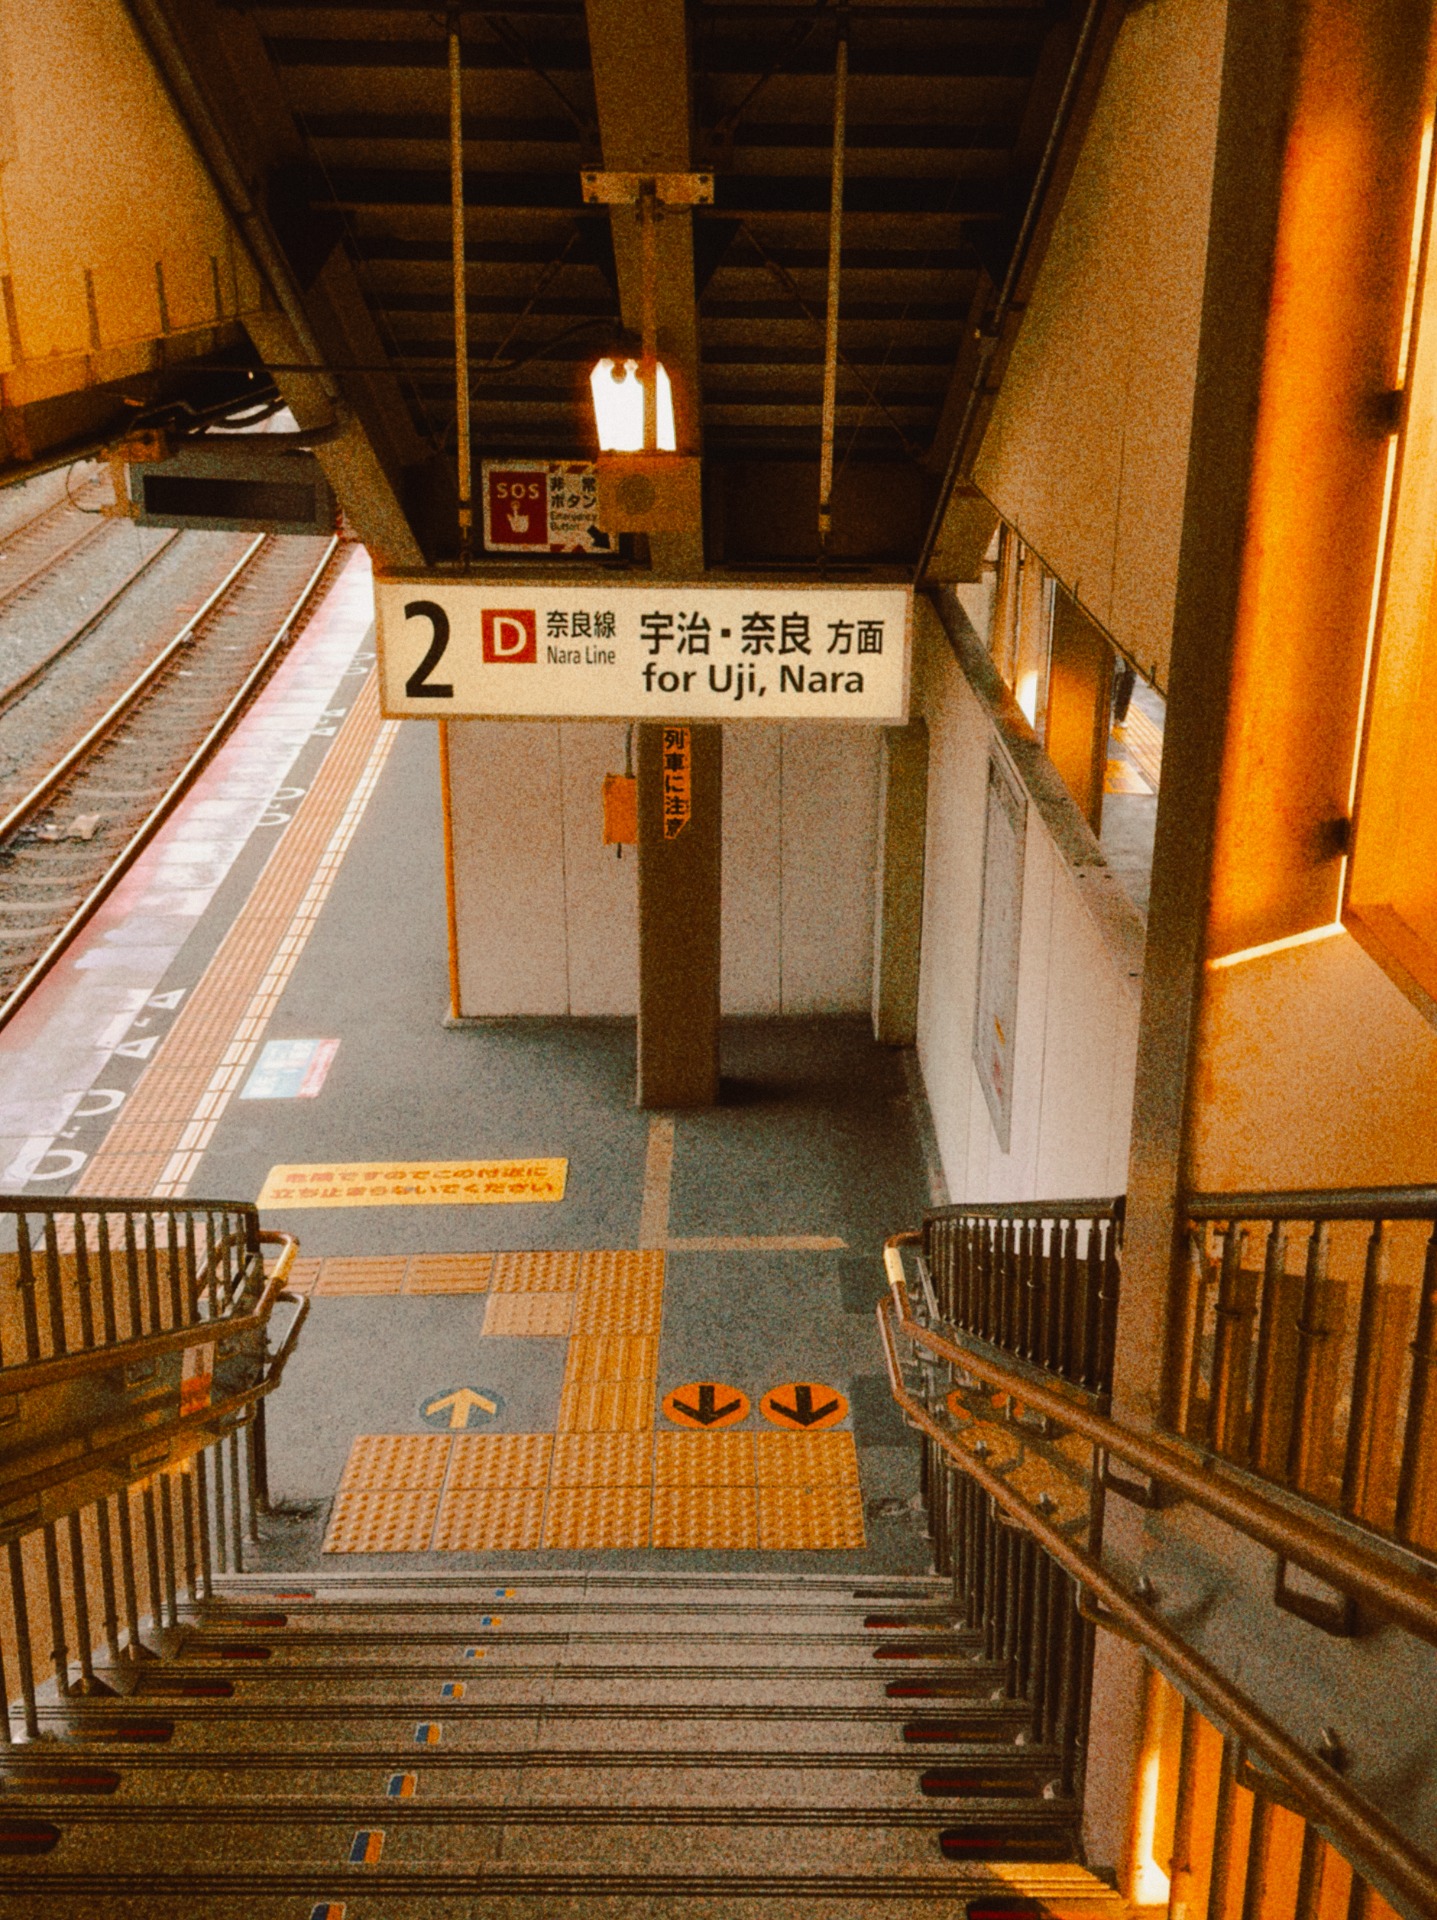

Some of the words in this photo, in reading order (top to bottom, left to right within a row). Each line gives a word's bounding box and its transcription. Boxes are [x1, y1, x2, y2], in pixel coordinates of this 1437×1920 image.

[496, 482, 540, 500] SOS
[550, 476, 597, 492] 非常
[550, 494, 597, 509] ボタン
[493, 616, 528, 656] D
[546, 609, 617, 639] 奈良線
[640, 611, 811, 656] 宇治・奈良
[827, 619, 884, 656] 方面
[403, 600, 454, 699] 2
[547, 645, 583, 664] Nara
[585, 645, 616, 664] Line
[642, 662, 697, 694] for
[709, 665, 767, 700] Uji,
[779, 664, 865, 694] Nara
